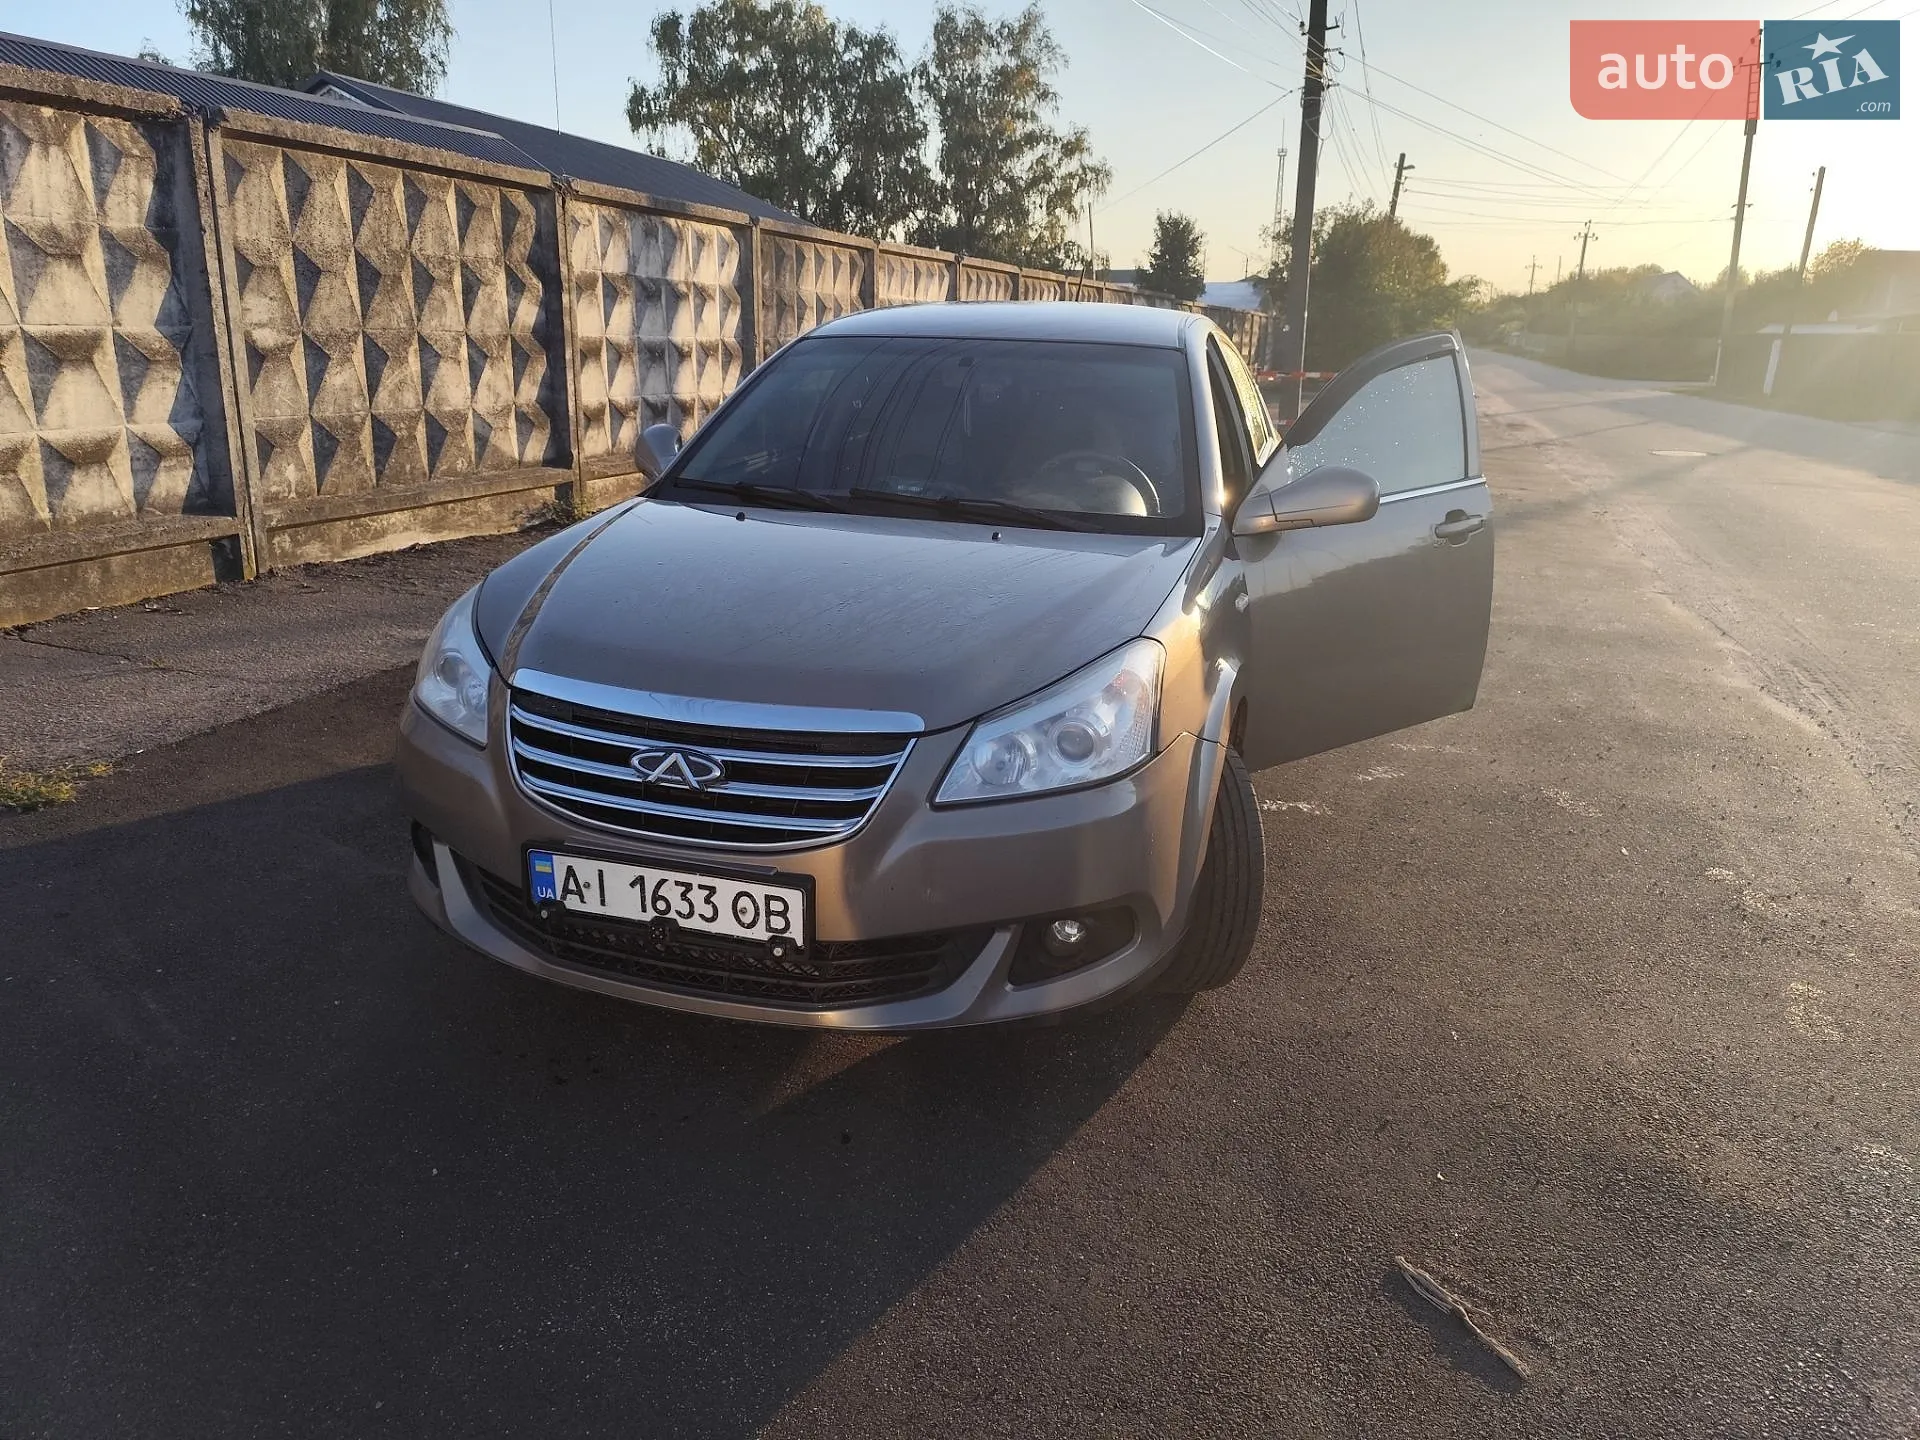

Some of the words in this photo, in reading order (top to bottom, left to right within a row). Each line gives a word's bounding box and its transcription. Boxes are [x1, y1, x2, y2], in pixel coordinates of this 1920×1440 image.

[537, 886, 555, 900] UA
[560, 865, 606, 907] AI
[629, 874, 719, 923] 1633
[731, 890, 791, 934] OB
